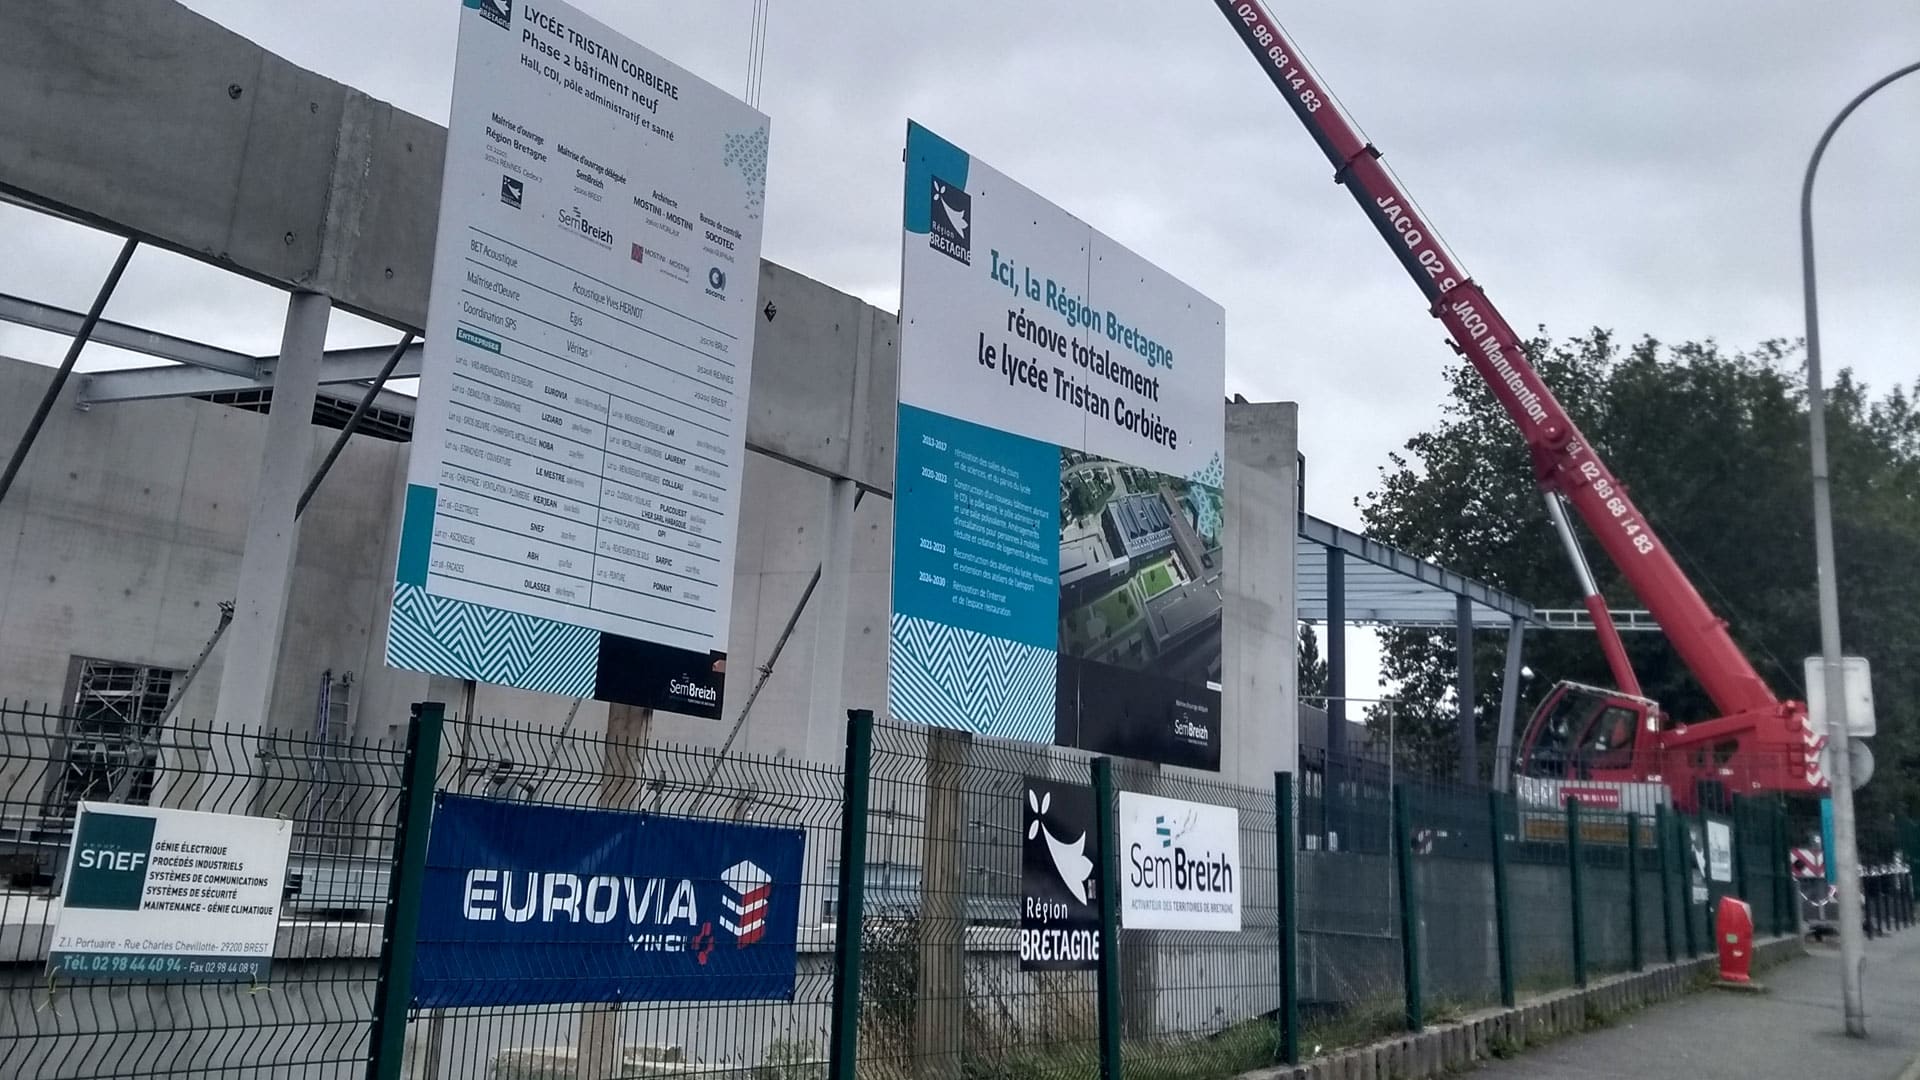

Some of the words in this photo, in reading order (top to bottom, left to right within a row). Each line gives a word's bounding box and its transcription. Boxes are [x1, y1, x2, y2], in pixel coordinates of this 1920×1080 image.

[524, 5, 564, 39] LYCÉE
[568, 28, 619, 68] TRISTAN
[621, 59, 679, 101] CORBIERE
[1238, 4, 1258, 26] 02
[1253, 24, 1273, 46] 98
[1268, 46, 1288, 68] 68
[1285, 68, 1306, 90] 14
[1300, 90, 1322, 112] 83
[522, 28, 560, 61] Phase
[563, 54, 571, 66] 2
[574, 55, 630, 97] bâtiment
[632, 88, 660, 114] neuf
[520, 53, 541, 75] Hall,
[543, 65, 562, 86] CDI,
[564, 75, 583, 97] pôle
[584, 85, 640, 126] administratif
[641, 117, 650, 130] et
[651, 121, 675, 142] santé
[485, 126, 512, 147] Région
[513, 139, 547, 163] Bretagne
[633, 196, 661, 217] MOSTINI
[666, 211, 693, 232] MOSTINI
[558, 208, 613, 245] SemBreizh
[1376, 195, 1422, 249] JACQ
[1418, 249, 1445, 278] 02
[705, 230, 735, 251] SOCOTEC
[471, 239, 482, 253] BET
[483, 245, 518, 268] Acoustique
[467, 271, 492, 290] Maîtrise
[572, 281, 605, 304] Acoustique
[463, 301, 504, 326] Coordination
[504, 317, 517, 330] SPS
[990, 248, 1019, 297] Ici,
[1025, 266, 1041, 302] la
[1046, 280, 1101, 333] Région
[1106, 311, 1173, 370] Bretagne
[567, 340, 588, 358] Véritas
[1007, 307, 1067, 358] rénove
[1071, 337, 1159, 402] totalement
[1451, 299, 1488, 340] JACQ
[1479, 334, 1550, 425] Manutention
[544, 386, 568, 400] EUROVIA
[978, 332, 996, 369] le
[1002, 342, 1048, 393] lycée
[1053, 367, 1109, 421] Tristan
[1114, 397, 1177, 450] Corbière
[541, 413, 562, 426] LIZIARD
[664, 453, 686, 465] LAURENT
[536, 467, 543, 476] LE
[544, 469, 565, 482] MESTRE
[662, 478, 683, 491] COLLEAU
[533, 495, 557, 508] KERJEAN
[1565, 435, 1583, 459] él.
[1580, 461, 1600, 481] 02
[1593, 479, 1614, 499] 98
[1606, 497, 1627, 517] 68
[1621, 518, 1640, 536] 14
[1633, 534, 1654, 554] 83
[524, 579, 550, 592] DILASSER
[653, 582, 672, 592] PONANT
[669, 679, 716, 701] SemBreizh
[1174, 719, 1208, 740] SemBreizh
[155, 840, 180, 852] GÉNIE
[180, 841, 227, 856] ÉLECTRIQUE
[152, 856, 194, 868] PROCÉDÉS
[195, 860, 243, 871] INDUSTRIELS
[1130, 842, 1233, 893] SemBreizh
[149, 870, 191, 882] SYSTÈMES
[192, 874, 203, 883] DE
[204, 875, 268, 886] COMMUNICATIONS
[146, 884, 188, 896] SYSTÈMES
[189, 888, 200, 897] DE
[201, 887, 237, 899] SÉCURITÉ
[463, 869, 698, 926] EUROVIA
[143, 901, 201, 912] MAINTENANCE
[207, 902, 230, 913] GÉNIE
[231, 905, 273, 915] CLIMATIQUE
[1026, 896, 1068, 924] Région
[1173, 901, 1203, 913] TERRITOIRES
[1203, 902, 1210, 913] DE
[58, 936, 72, 947] Z.I.
[75, 937, 116, 949] Portuaire
[124, 939, 140, 949] Rue
[142, 939, 173, 950] Charles
[220, 942, 242, 952] 29200
[243, 942, 268, 952] BREST
[1020, 928, 1099, 961] BRETAGNE
[64, 954, 88, 970] Tél.
[92, 956, 109, 970] 02
[112, 956, 128, 971] 98
[129, 957, 145, 971] 44
[148, 957, 164, 971] 40
[167, 958, 181, 972] 94
[189, 961, 203, 972] Fax
[205, 962, 215, 972] 02
[217, 962, 226, 972] 98
[228, 963, 237, 972] 44
[239, 963, 248, 973] 08
